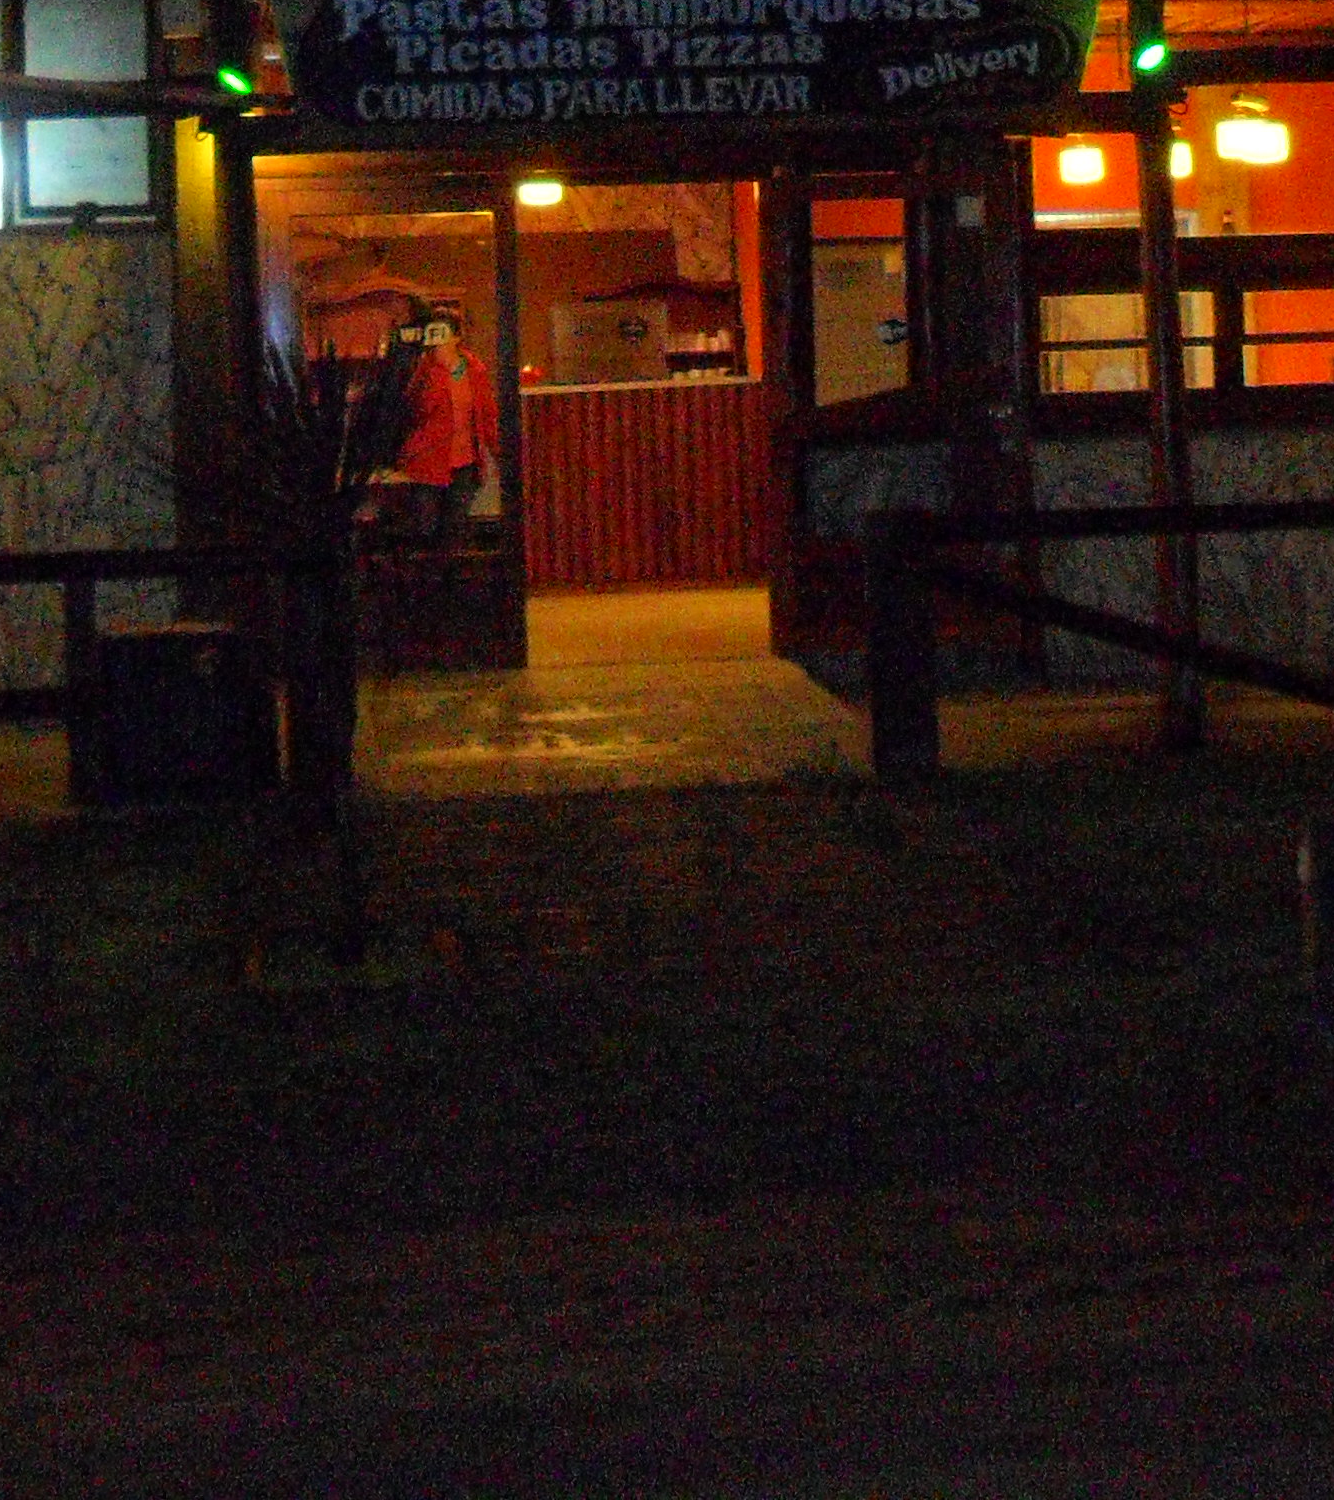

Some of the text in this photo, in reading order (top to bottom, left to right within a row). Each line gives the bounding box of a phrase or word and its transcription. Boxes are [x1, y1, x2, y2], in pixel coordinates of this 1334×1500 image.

[386, 27, 825, 74] Picadas Pizzas
[877, 40, 1039, 102] Delivery
[354, 72, 812, 122] COMIDAS PARA LLEVAR
